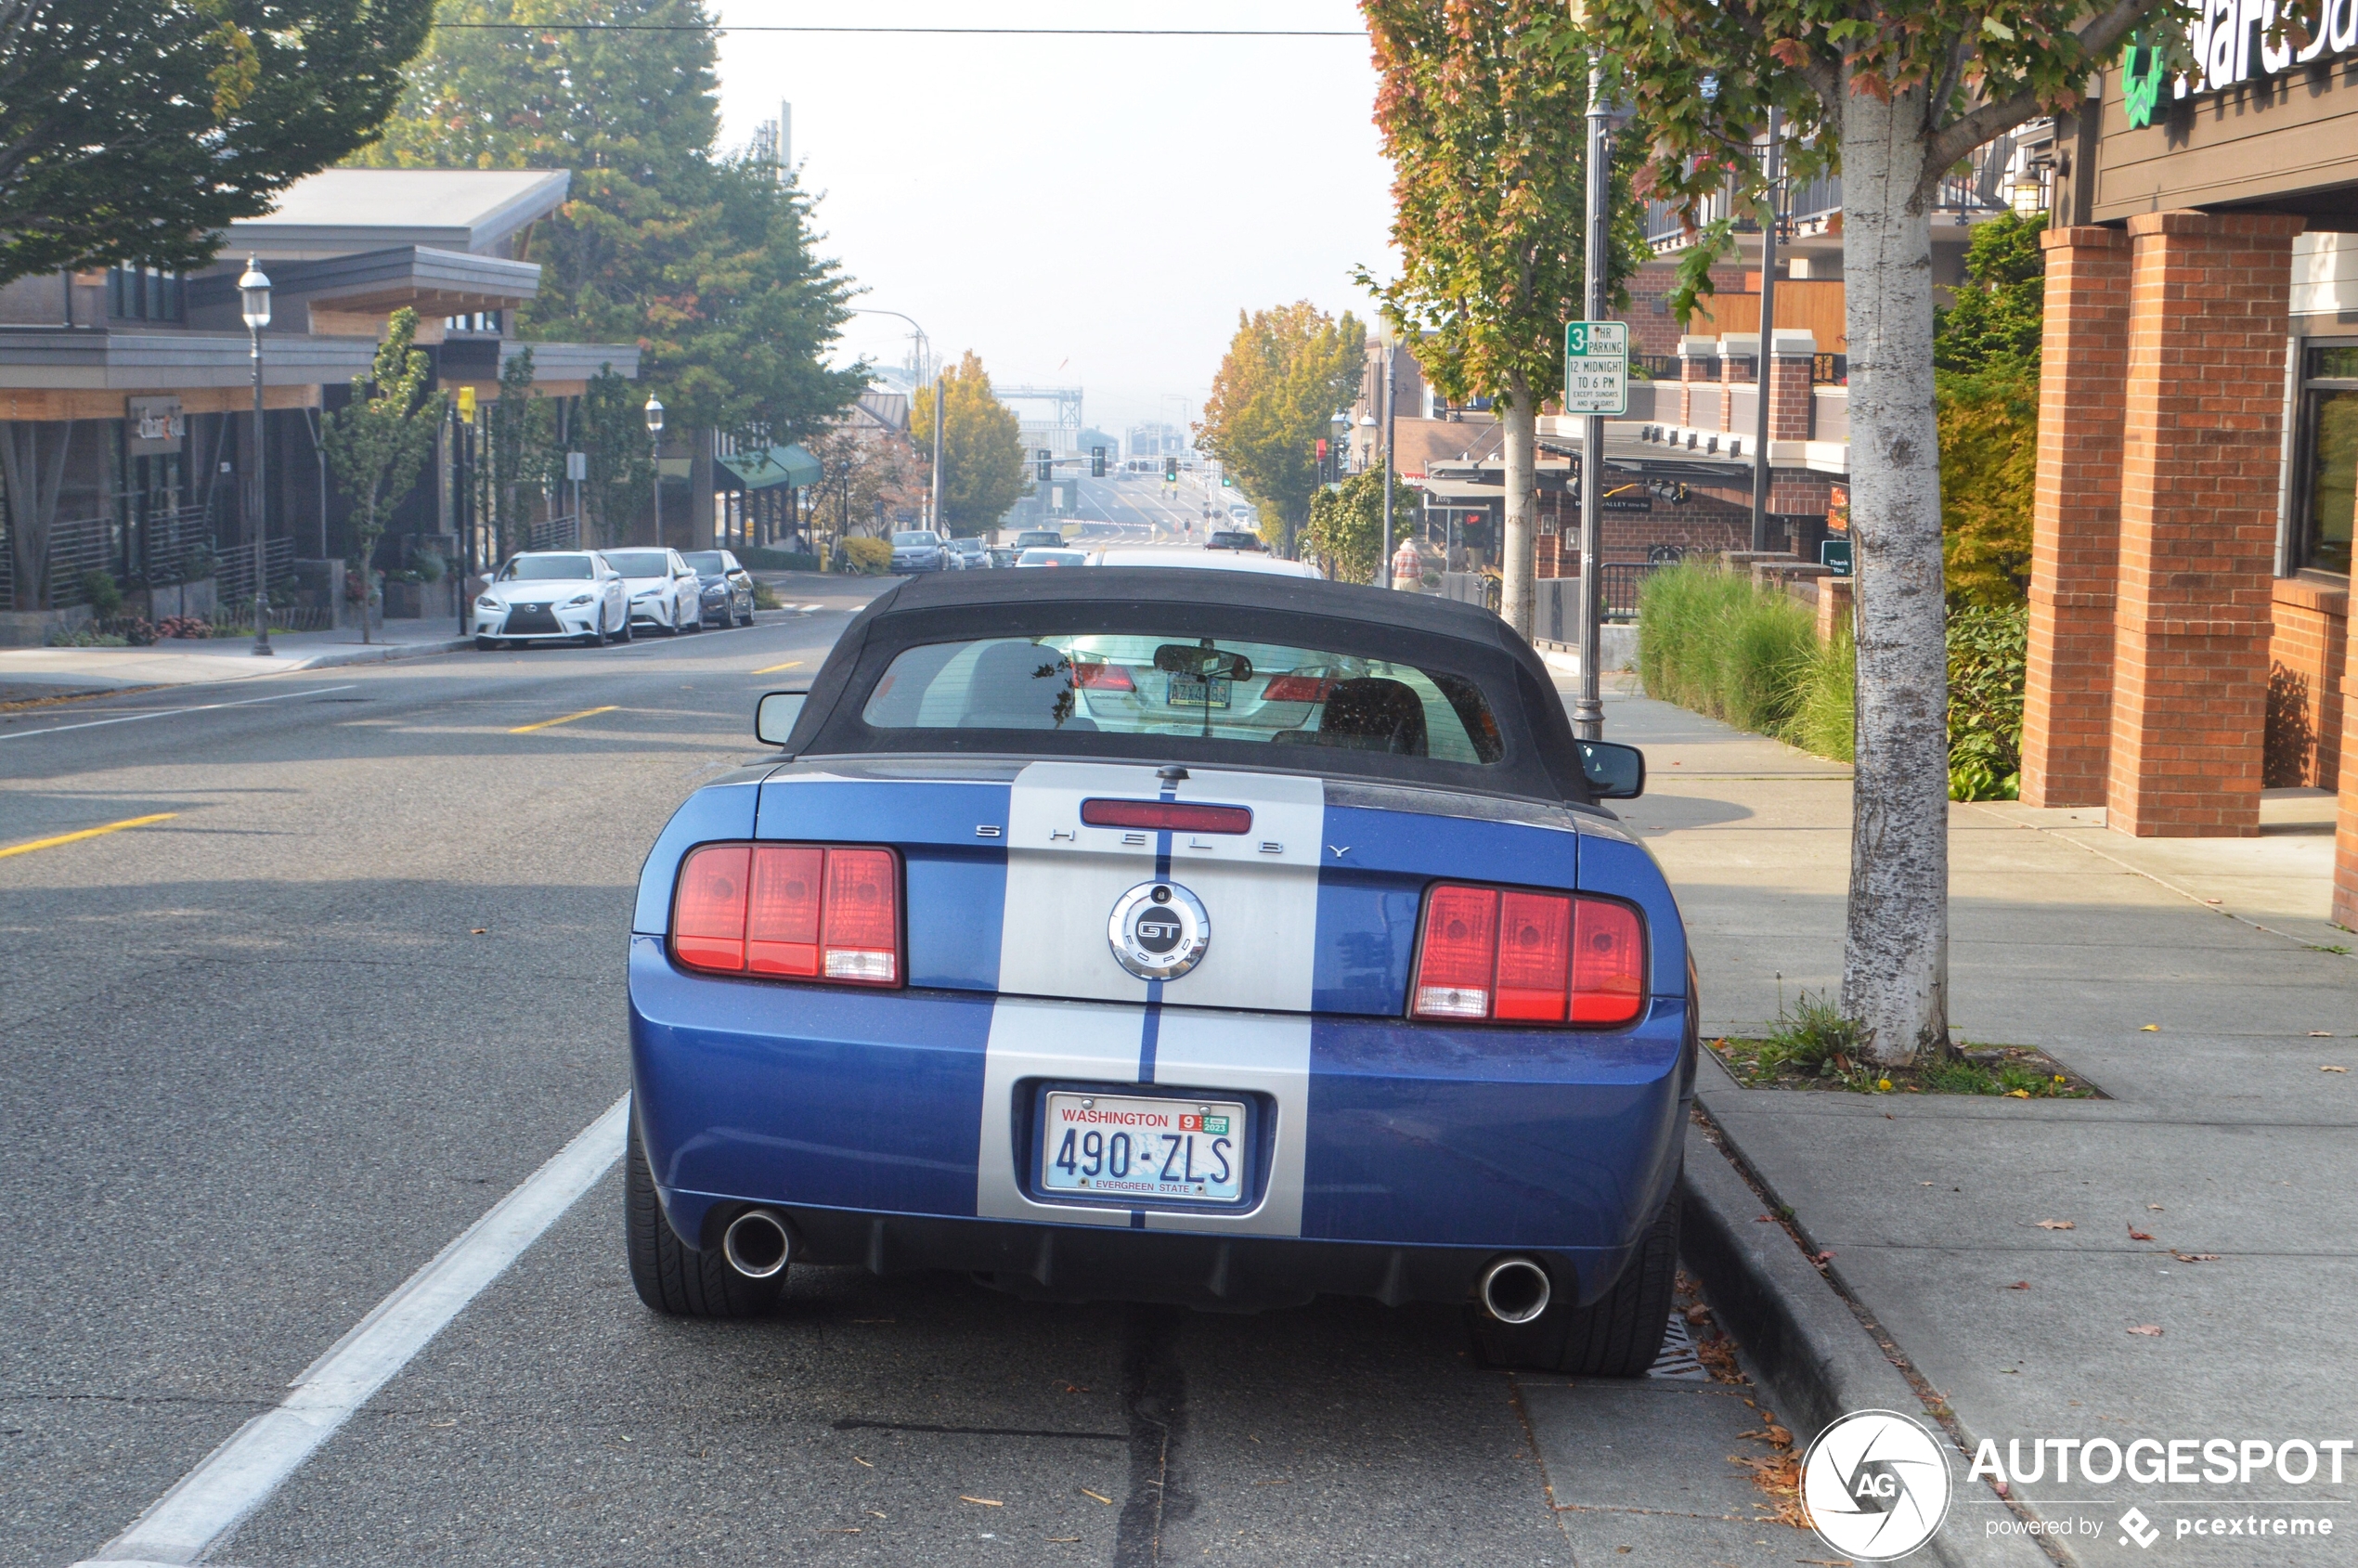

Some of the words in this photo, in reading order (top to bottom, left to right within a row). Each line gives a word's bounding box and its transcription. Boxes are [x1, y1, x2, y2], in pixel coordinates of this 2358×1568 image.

[1600, 328, 1611, 338] HR
[1588, 342, 1622, 353] PARKING
[1570, 361, 1578, 372] 12
[1584, 361, 1622, 372] MIDNIGHT
[1578, 377, 1587, 388] TO
[1592, 377, 1598, 388] 6
[1603, 377, 1614, 388] PM
[1172, 684, 1226, 702] AZX499
[976, 824, 1352, 858] SHELBY
[1138, 921, 1180, 939] GT
[1125, 934, 1191, 964] FORD
[1062, 1109, 1168, 1127] WASHINGTON
[1184, 1116, 1195, 1129] 9
[1204, 1123, 1225, 1132] 2023
[1095, 1180, 1154, 1191] EVERGREEN
[1159, 1184, 1189, 1193] STATE
